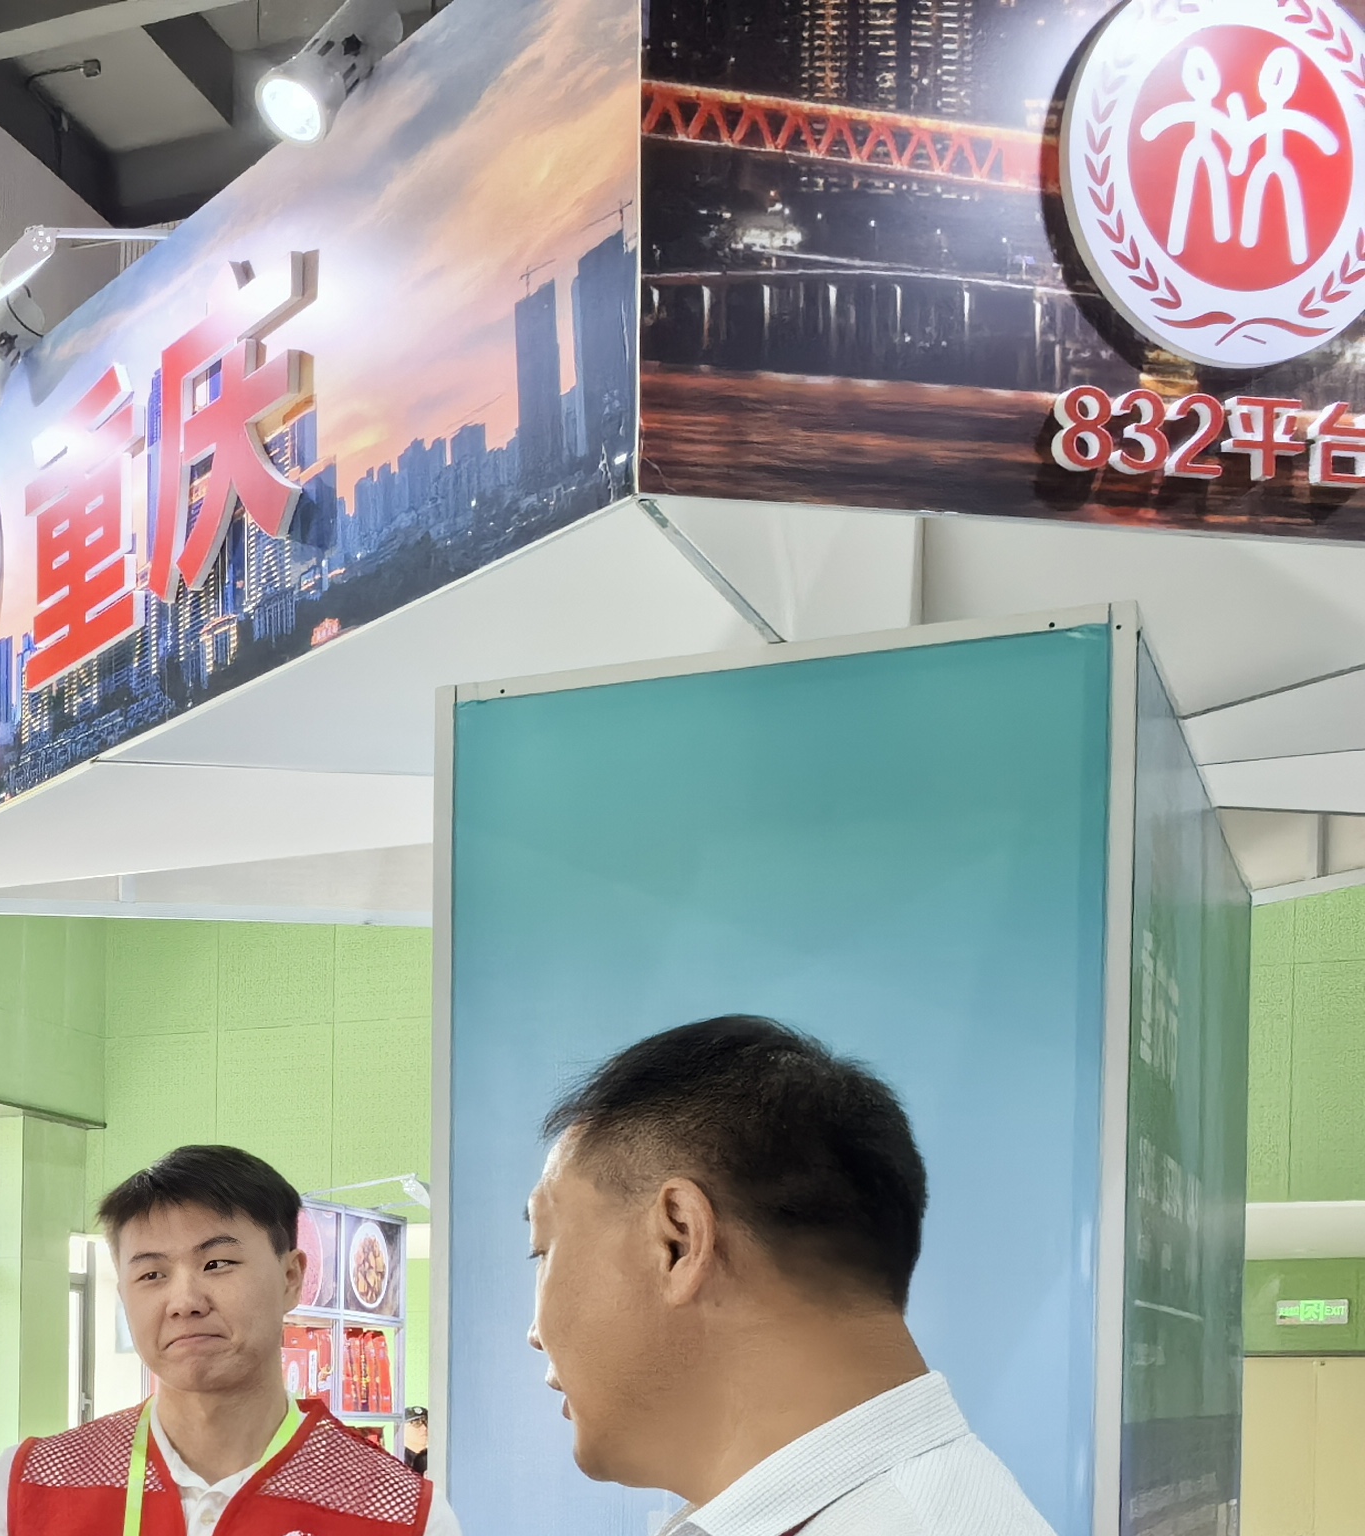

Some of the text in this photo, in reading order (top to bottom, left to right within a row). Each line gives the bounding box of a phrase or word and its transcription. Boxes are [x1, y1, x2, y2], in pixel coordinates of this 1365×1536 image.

[25, 250, 319, 692] 重庆
[1052, 385, 1365, 488] 832平台
[1325, 1306, 1345, 1316] EXIT
